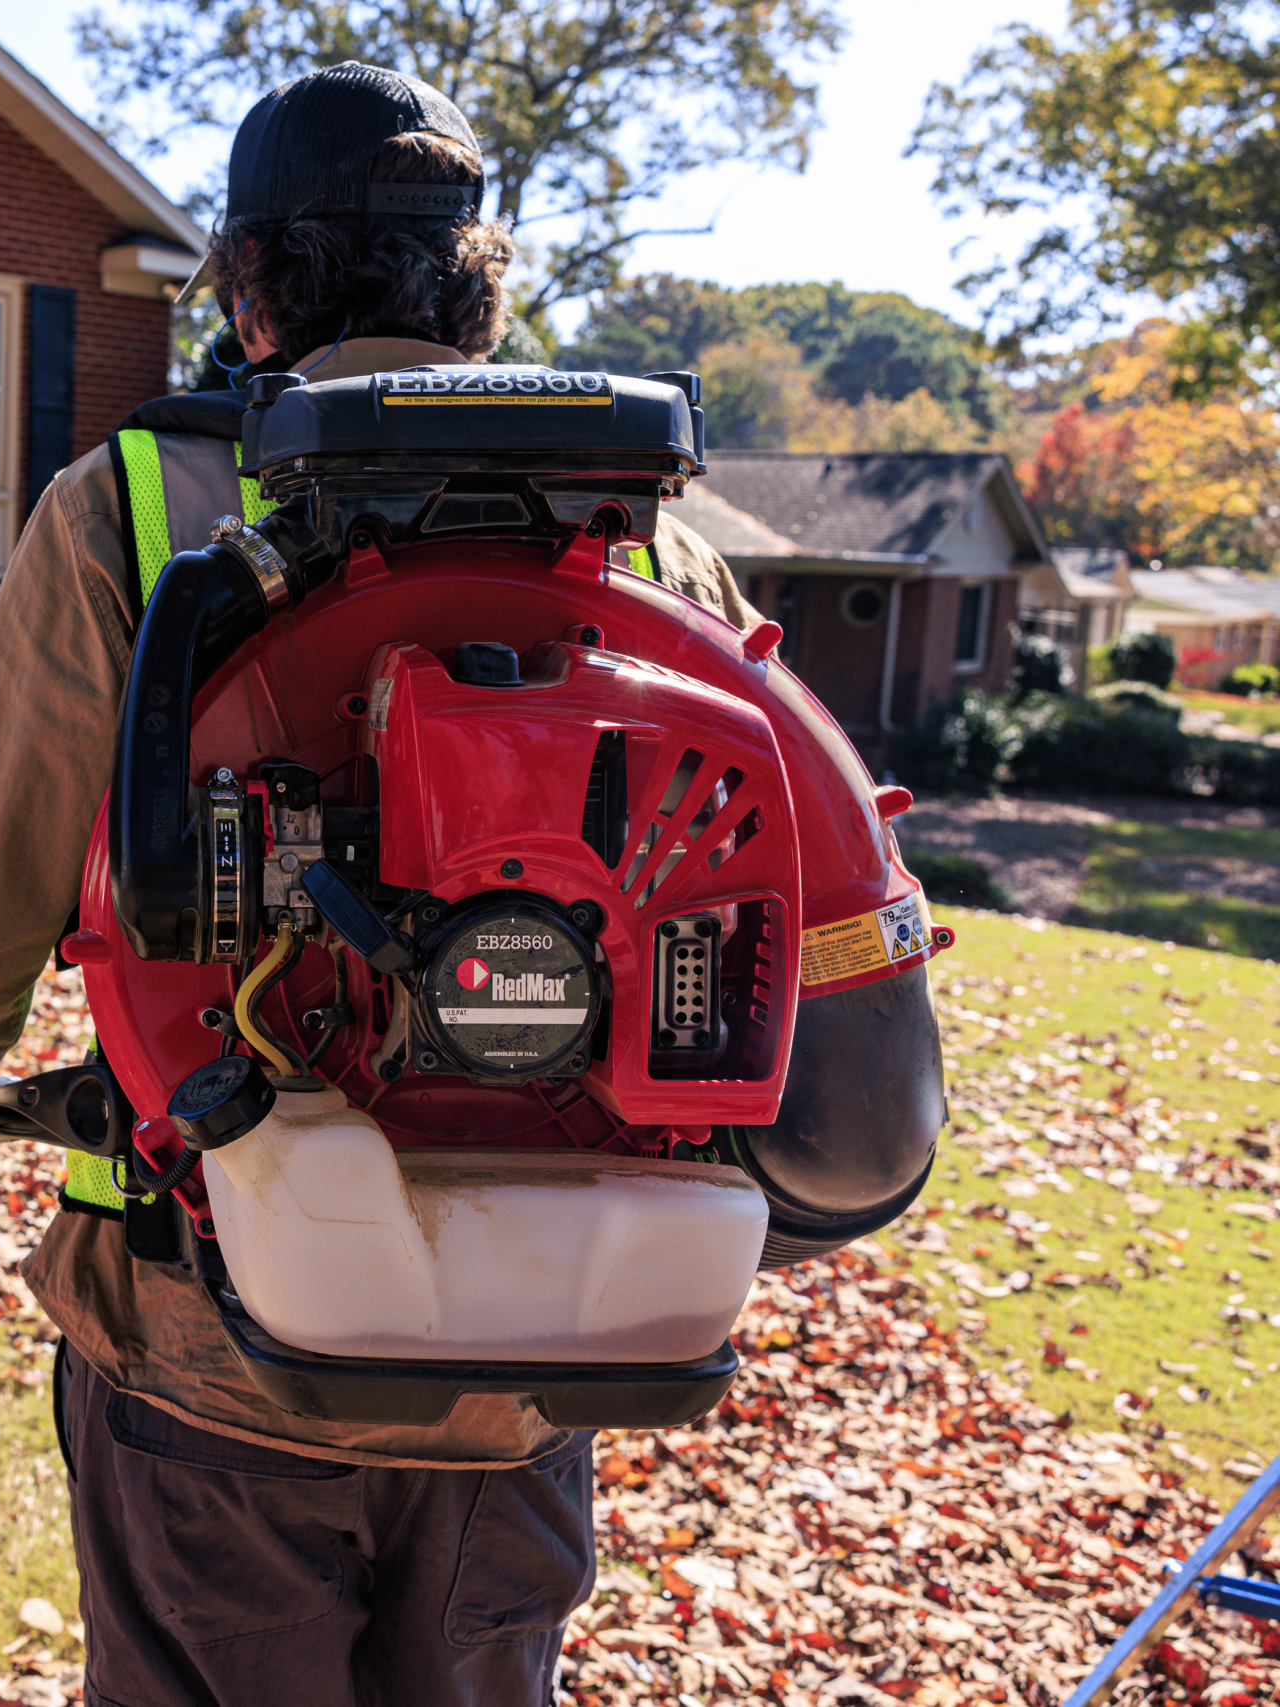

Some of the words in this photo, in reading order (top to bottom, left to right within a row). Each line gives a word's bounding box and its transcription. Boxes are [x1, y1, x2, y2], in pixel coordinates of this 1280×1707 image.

[388, 373, 602, 393] EBZ8560
[286, 814, 296, 824] 12
[881, 911, 895, 924] 79
[817, 920, 862, 937] WARNING!
[476, 935, 553, 950] EBZ8560
[836, 932, 862, 943] equipment
